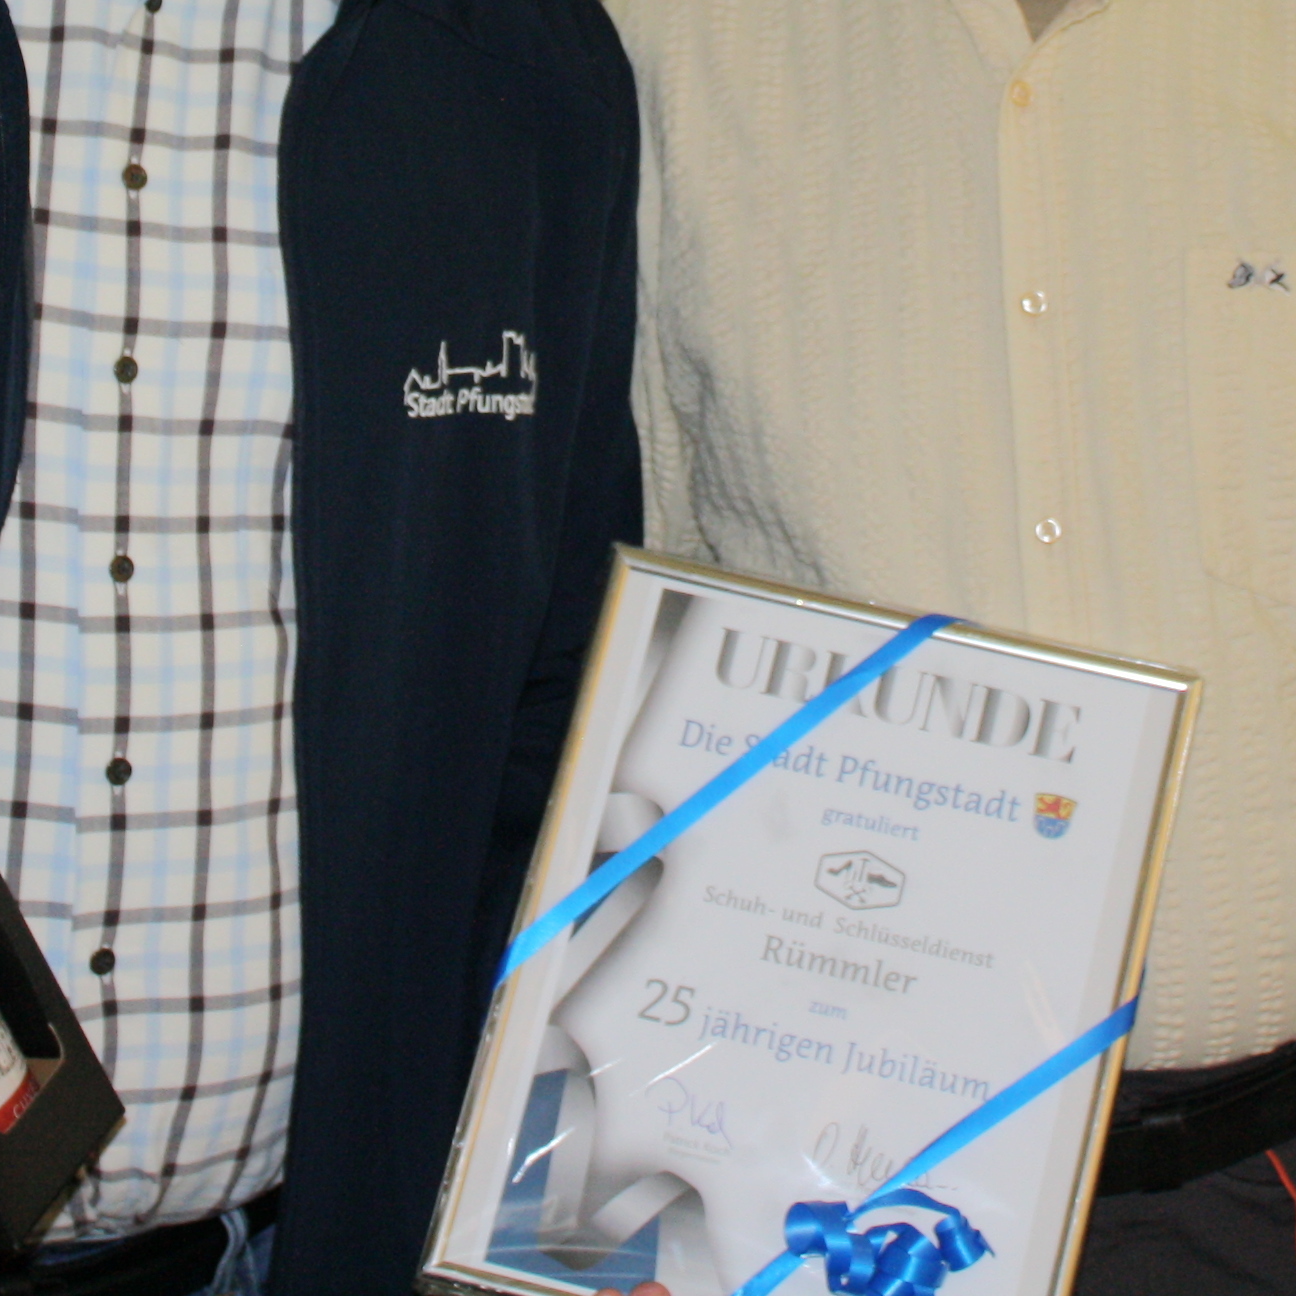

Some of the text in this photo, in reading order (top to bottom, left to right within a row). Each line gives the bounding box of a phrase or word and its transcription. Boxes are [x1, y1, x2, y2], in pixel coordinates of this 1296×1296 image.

[407, 389, 454, 418] Stadt
[679, 718, 732, 756] Die
[835, 754, 1022, 822] Pfungstadt
[820, 806, 920, 842] gratuliert
[703, 884, 995, 970] Schuh- und Schlüsseldienst
[759, 934, 918, 994] Rümmler
[808, 999, 848, 1020] zum
[637, 977, 992, 1104] 25 jährigen Jubiläum
